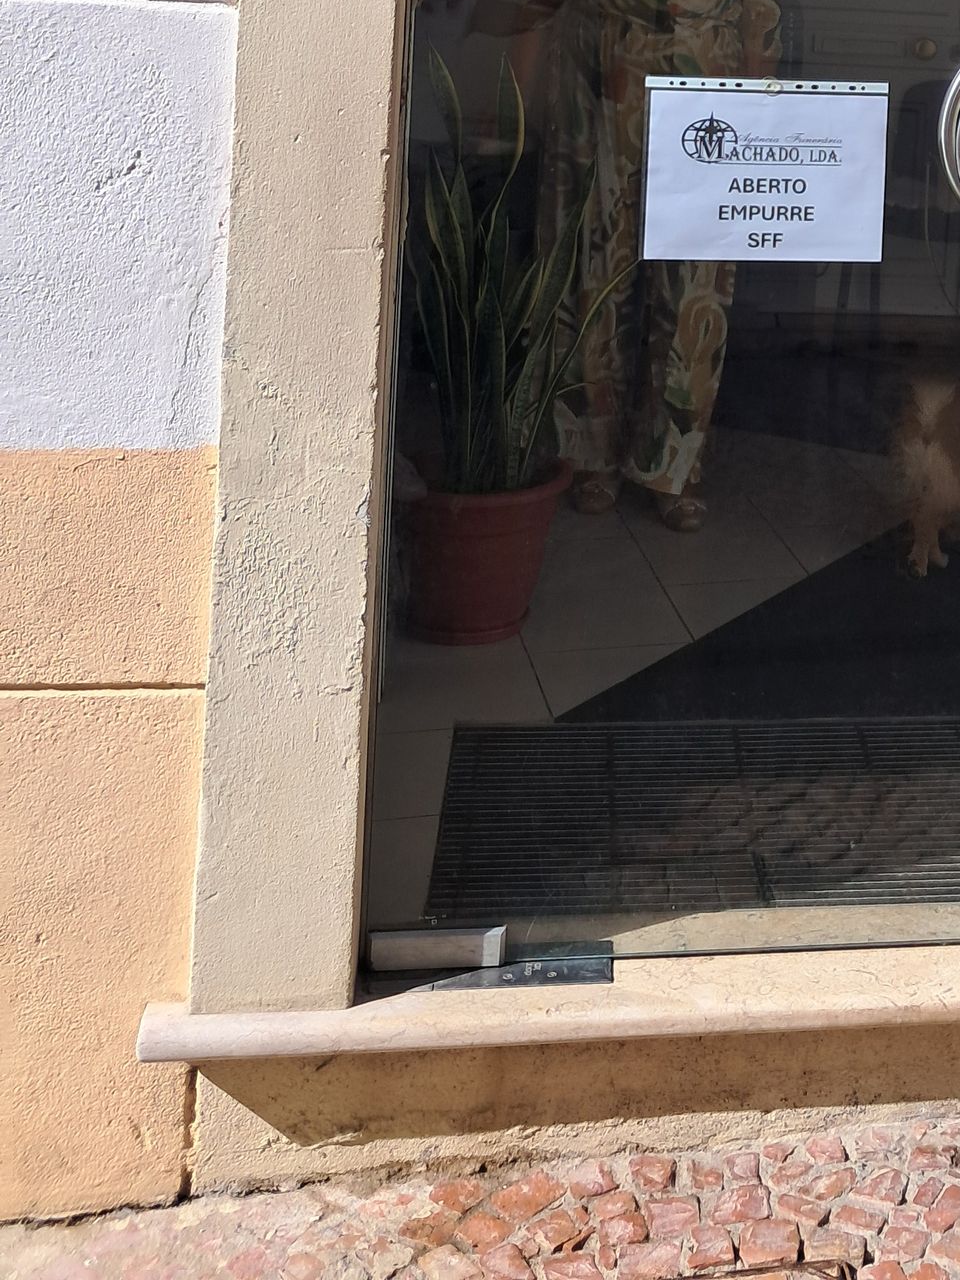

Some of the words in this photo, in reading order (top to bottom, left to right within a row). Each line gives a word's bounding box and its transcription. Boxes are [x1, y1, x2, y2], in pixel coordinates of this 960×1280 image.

[809, 148, 842, 163] LDA.
[728, 177, 807, 194] ABERTO
[718, 205, 815, 221] EMPURRE
[747, 232, 783, 249] SFF
